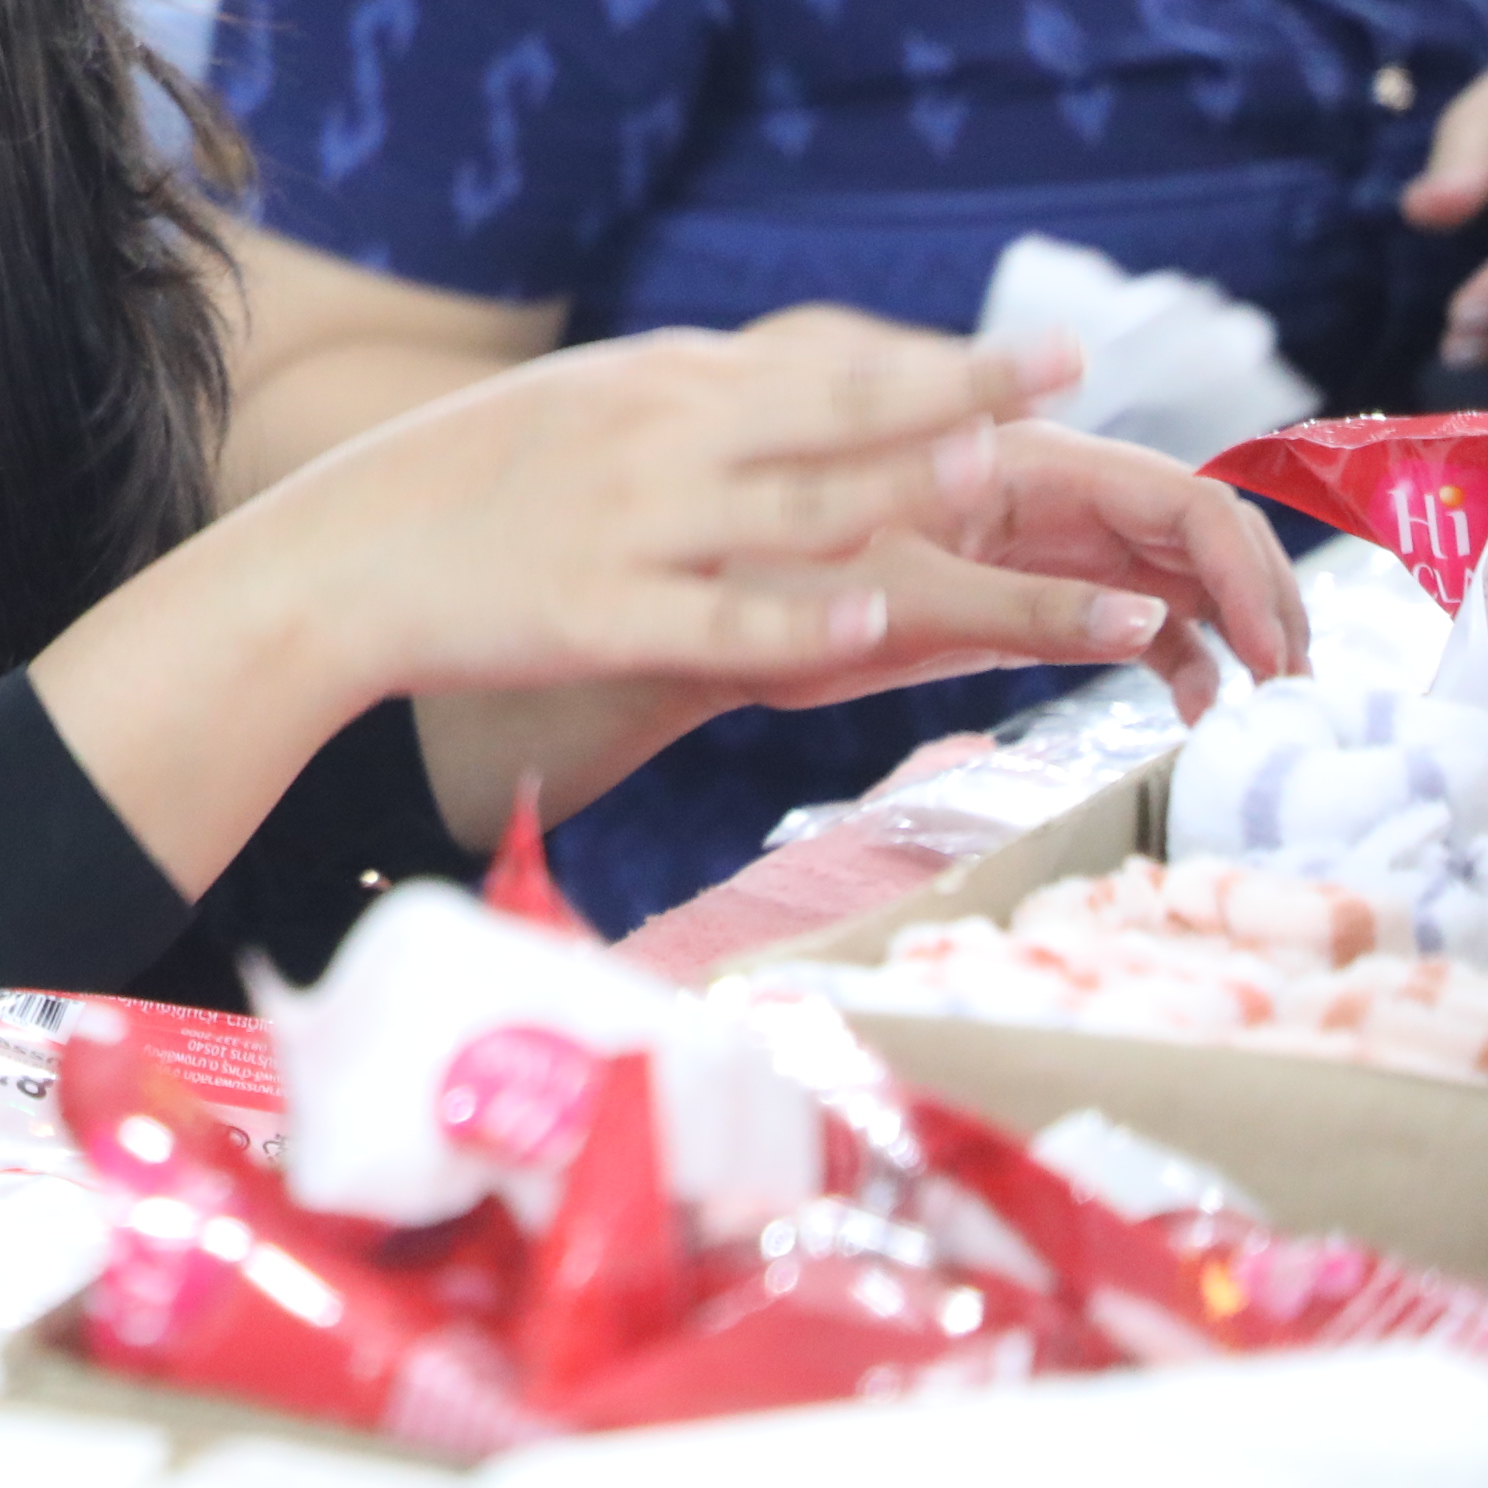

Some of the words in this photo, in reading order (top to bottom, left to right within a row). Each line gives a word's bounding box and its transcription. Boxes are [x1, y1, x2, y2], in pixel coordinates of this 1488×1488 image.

[1387, 485, 1471, 559] Hi
[187, 1040, 228, 1059] 10540
[182, 1069, 282, 1098] าหกรรมพลาสติก
